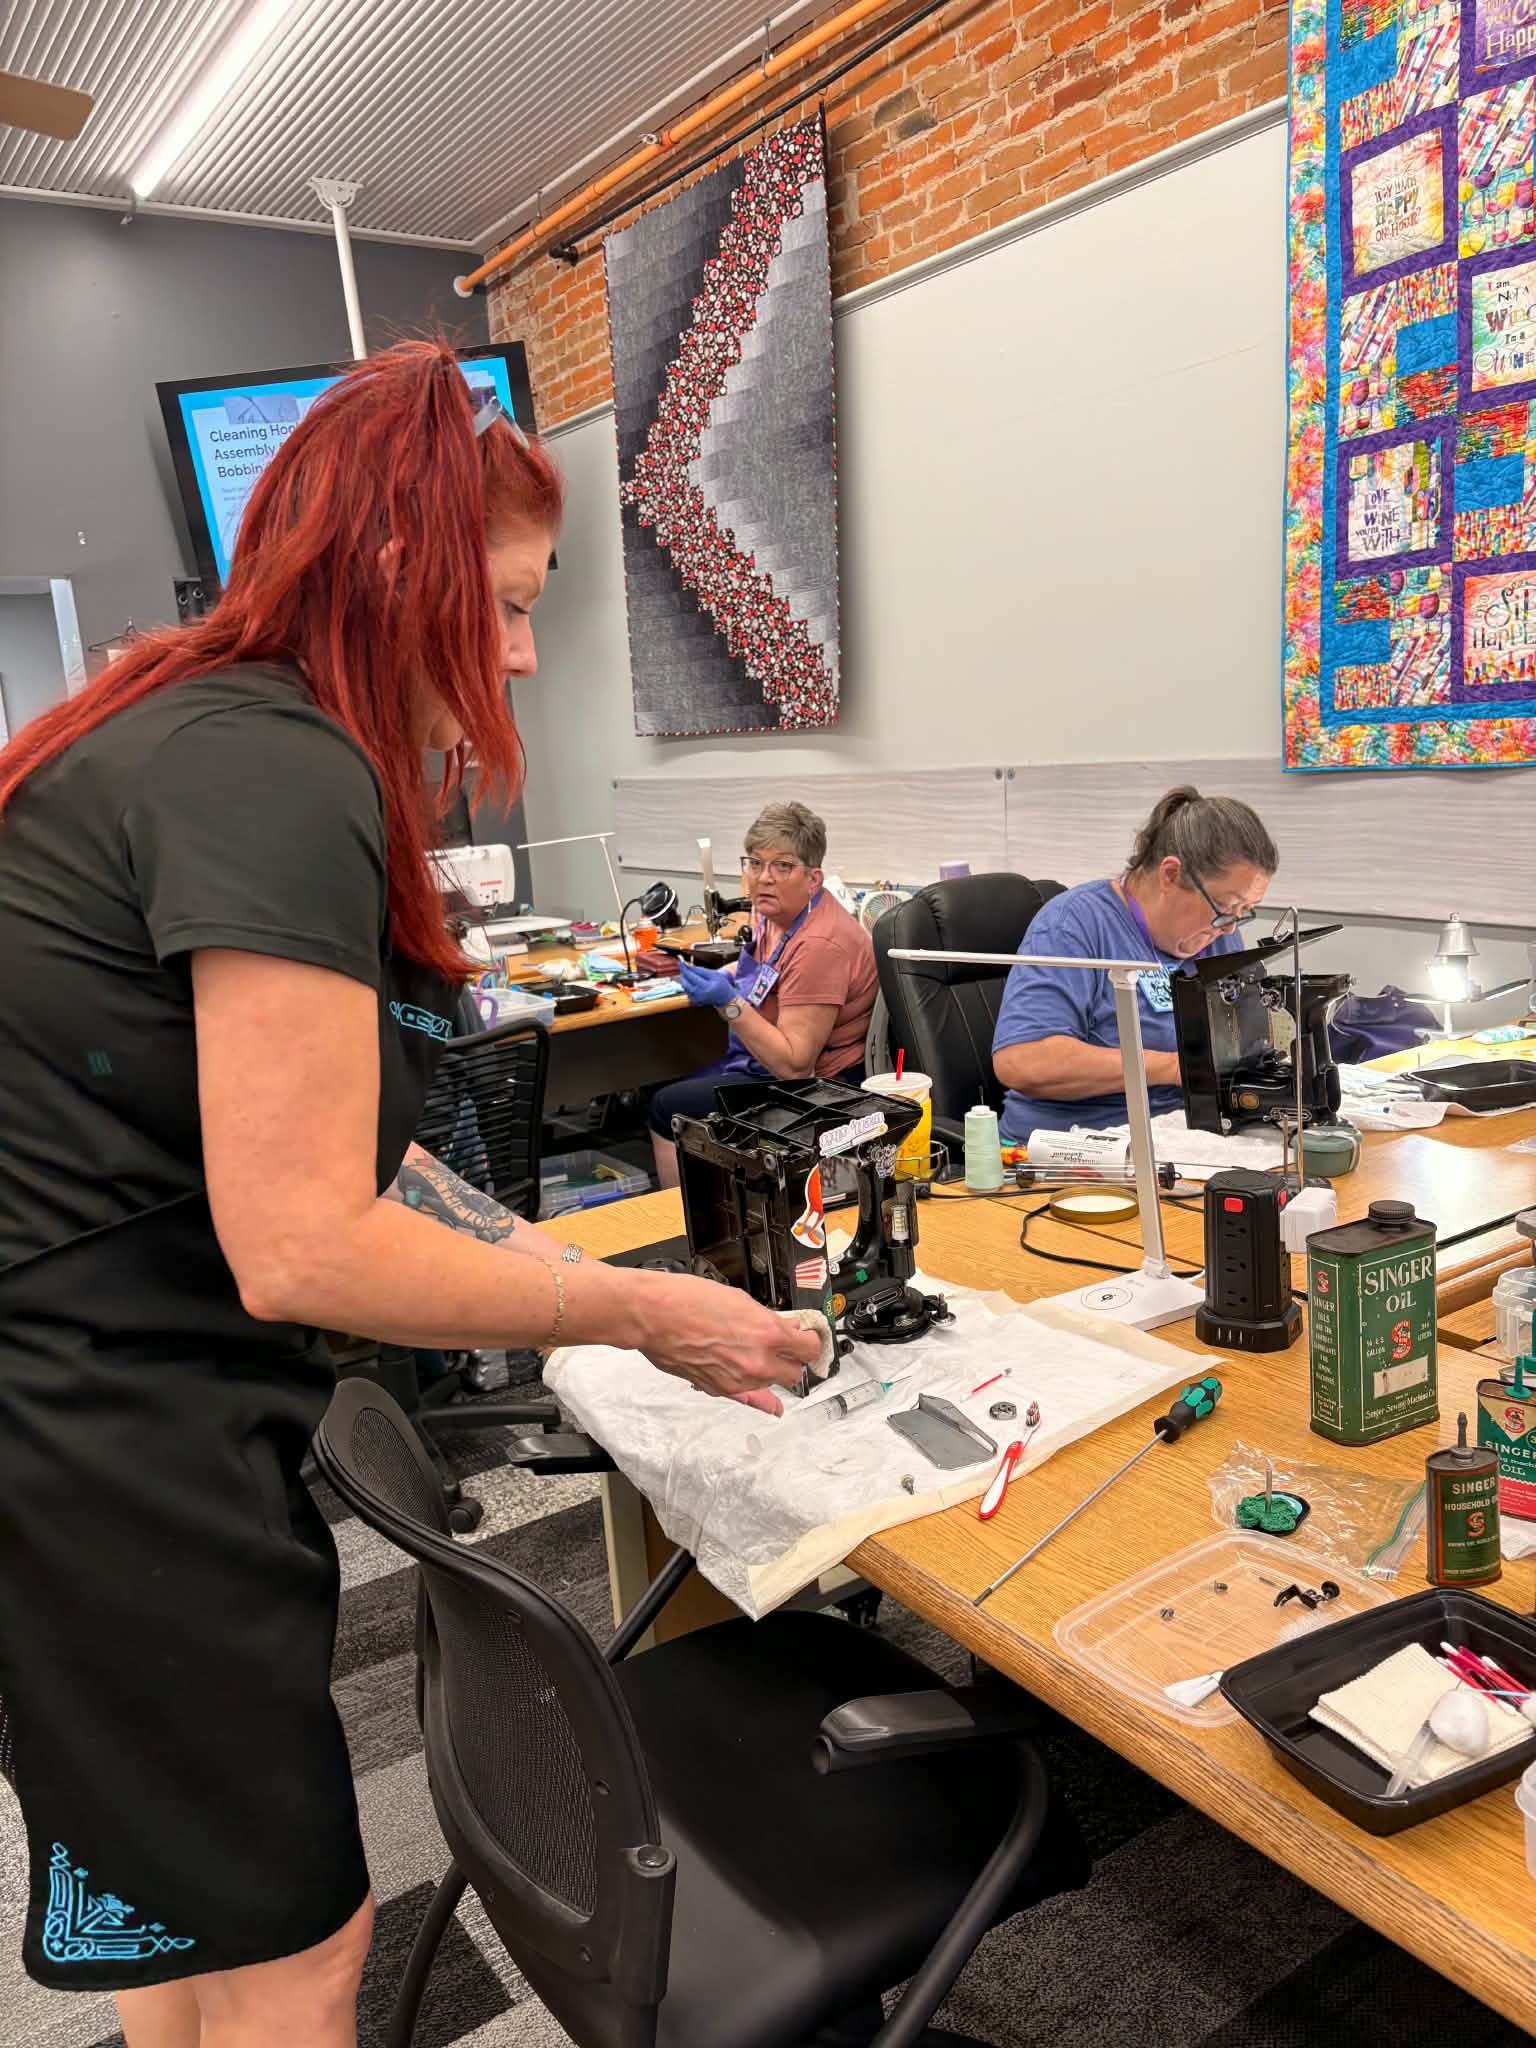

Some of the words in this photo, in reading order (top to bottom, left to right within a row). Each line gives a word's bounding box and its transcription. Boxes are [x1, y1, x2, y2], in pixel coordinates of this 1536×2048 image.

[209, 426, 268, 442] Cleaning
[215, 443, 276, 461] Assembly
[217, 463, 264, 478] Bobbin
[1364, 1255, 1433, 1296] SINGER
[1313, 1296, 1336, 1312] SINGER
[1386, 1290, 1417, 1313] OIL
[1501, 1464, 1526, 1476] OIL
[1452, 1476, 1496, 1495] SINGER
[1444, 1498, 1490, 1511] HOUSEHOLD
